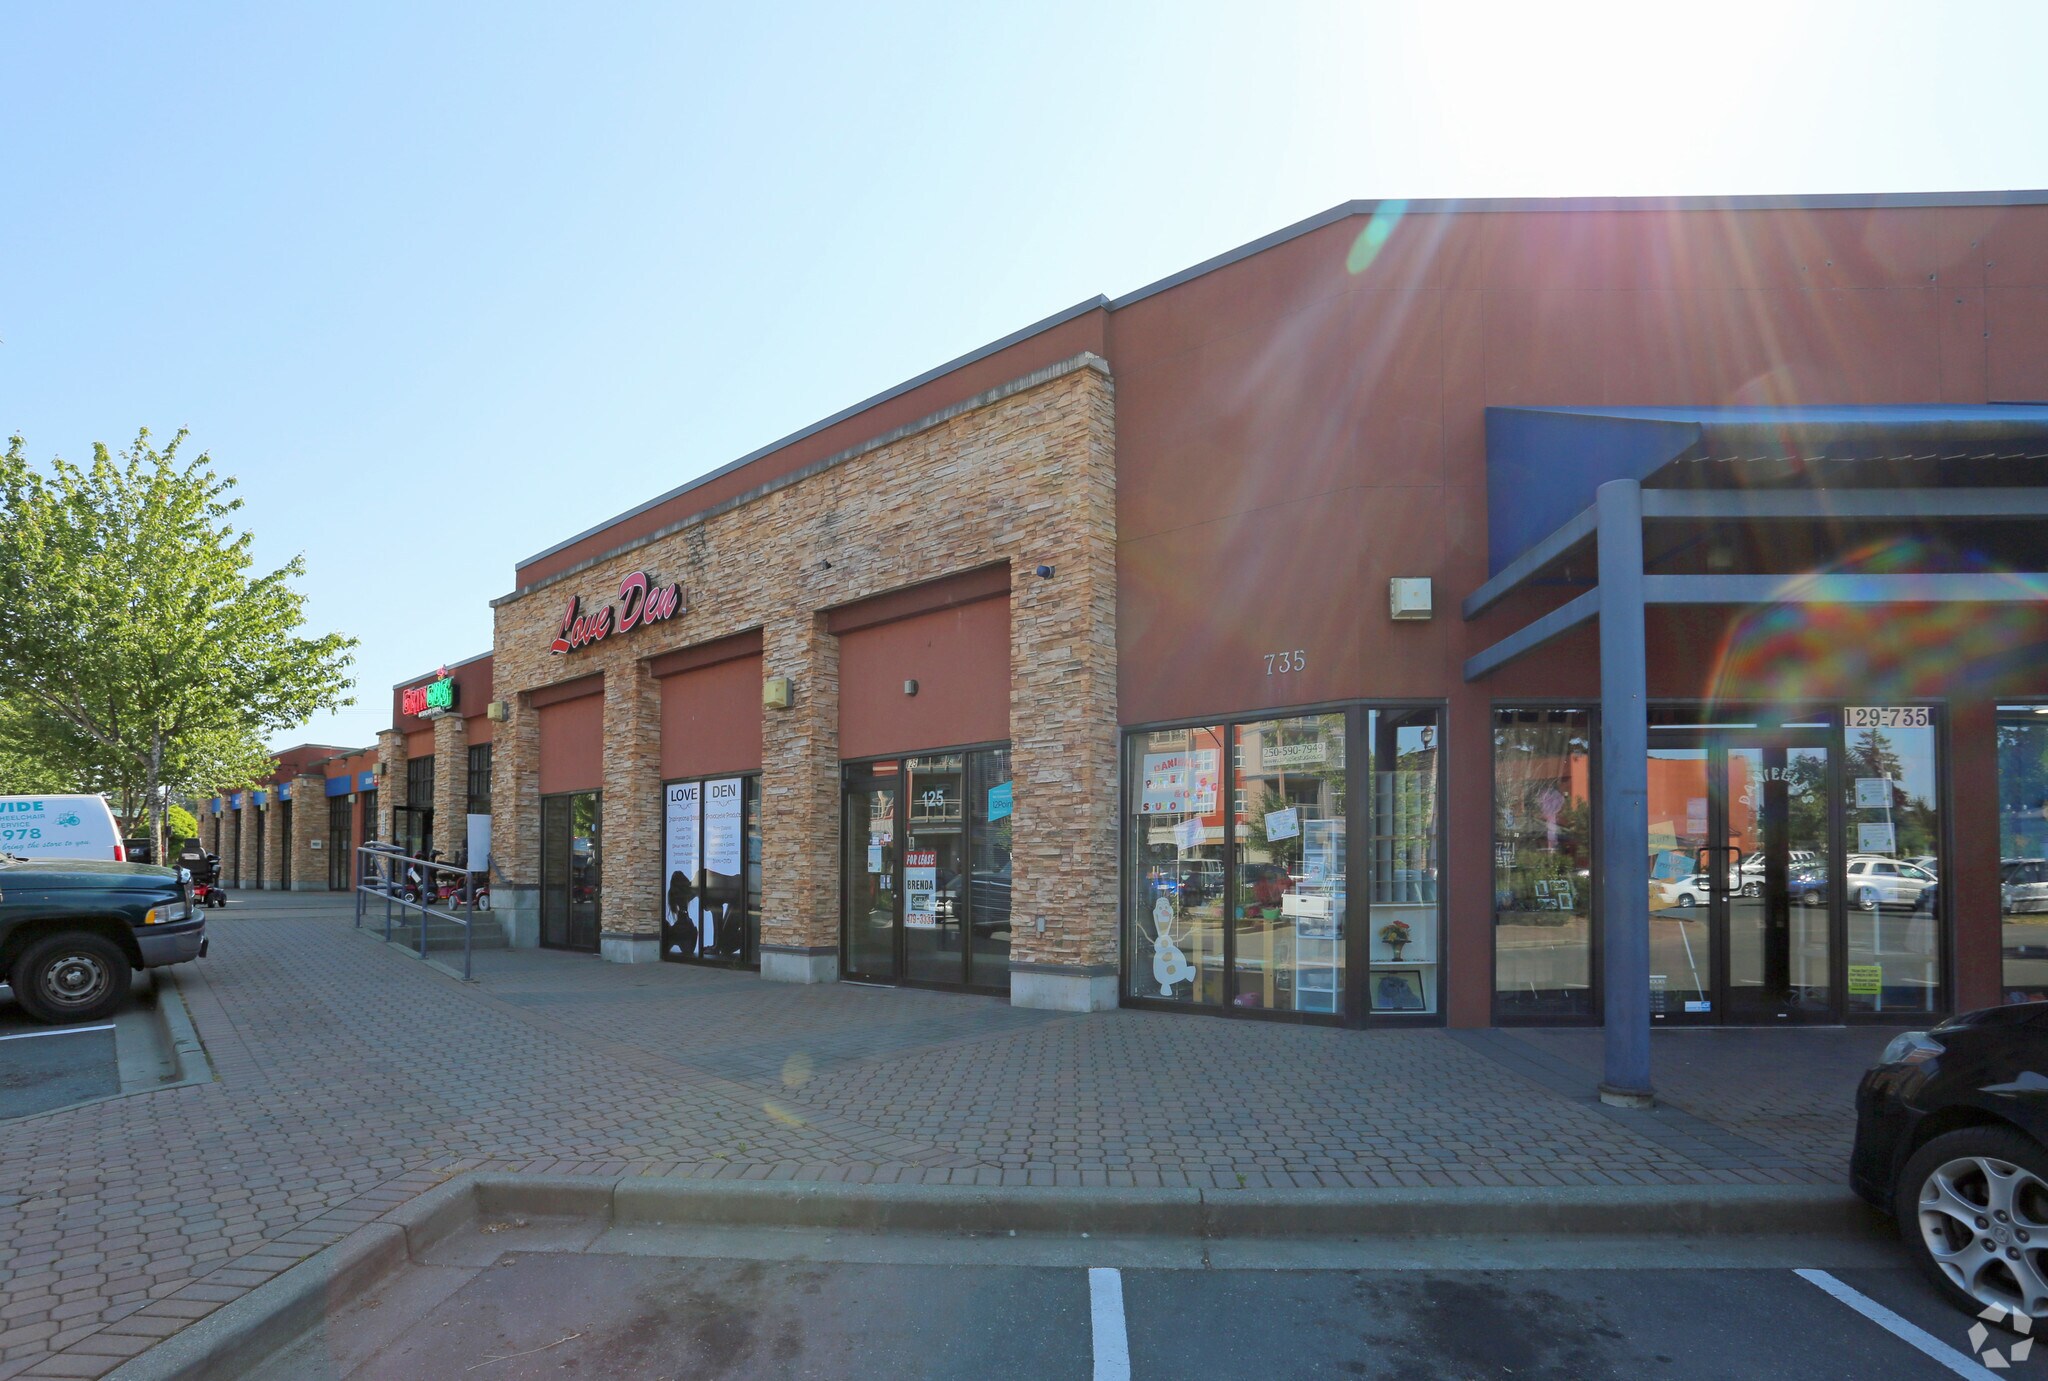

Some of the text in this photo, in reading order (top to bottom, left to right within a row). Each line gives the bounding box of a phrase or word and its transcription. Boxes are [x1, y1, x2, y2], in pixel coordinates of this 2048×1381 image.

[549, 571, 681, 655] Love Den
[1263, 649, 1305, 675] 735
[1263, 743, 1323, 758] 250-590-7949
[905, 758, 919, 769] 125
[671, 783, 736, 802] LOVE DEN
[921, 790, 945, 808] 125
[2, 842, 25, 852] bring
[27, 841, 40, 849] the
[42, 840, 63, 848] store
[65, 839, 73, 847] to
[906, 854, 935, 865] FOR LEASE
[907, 880, 934, 890] BRENDA
